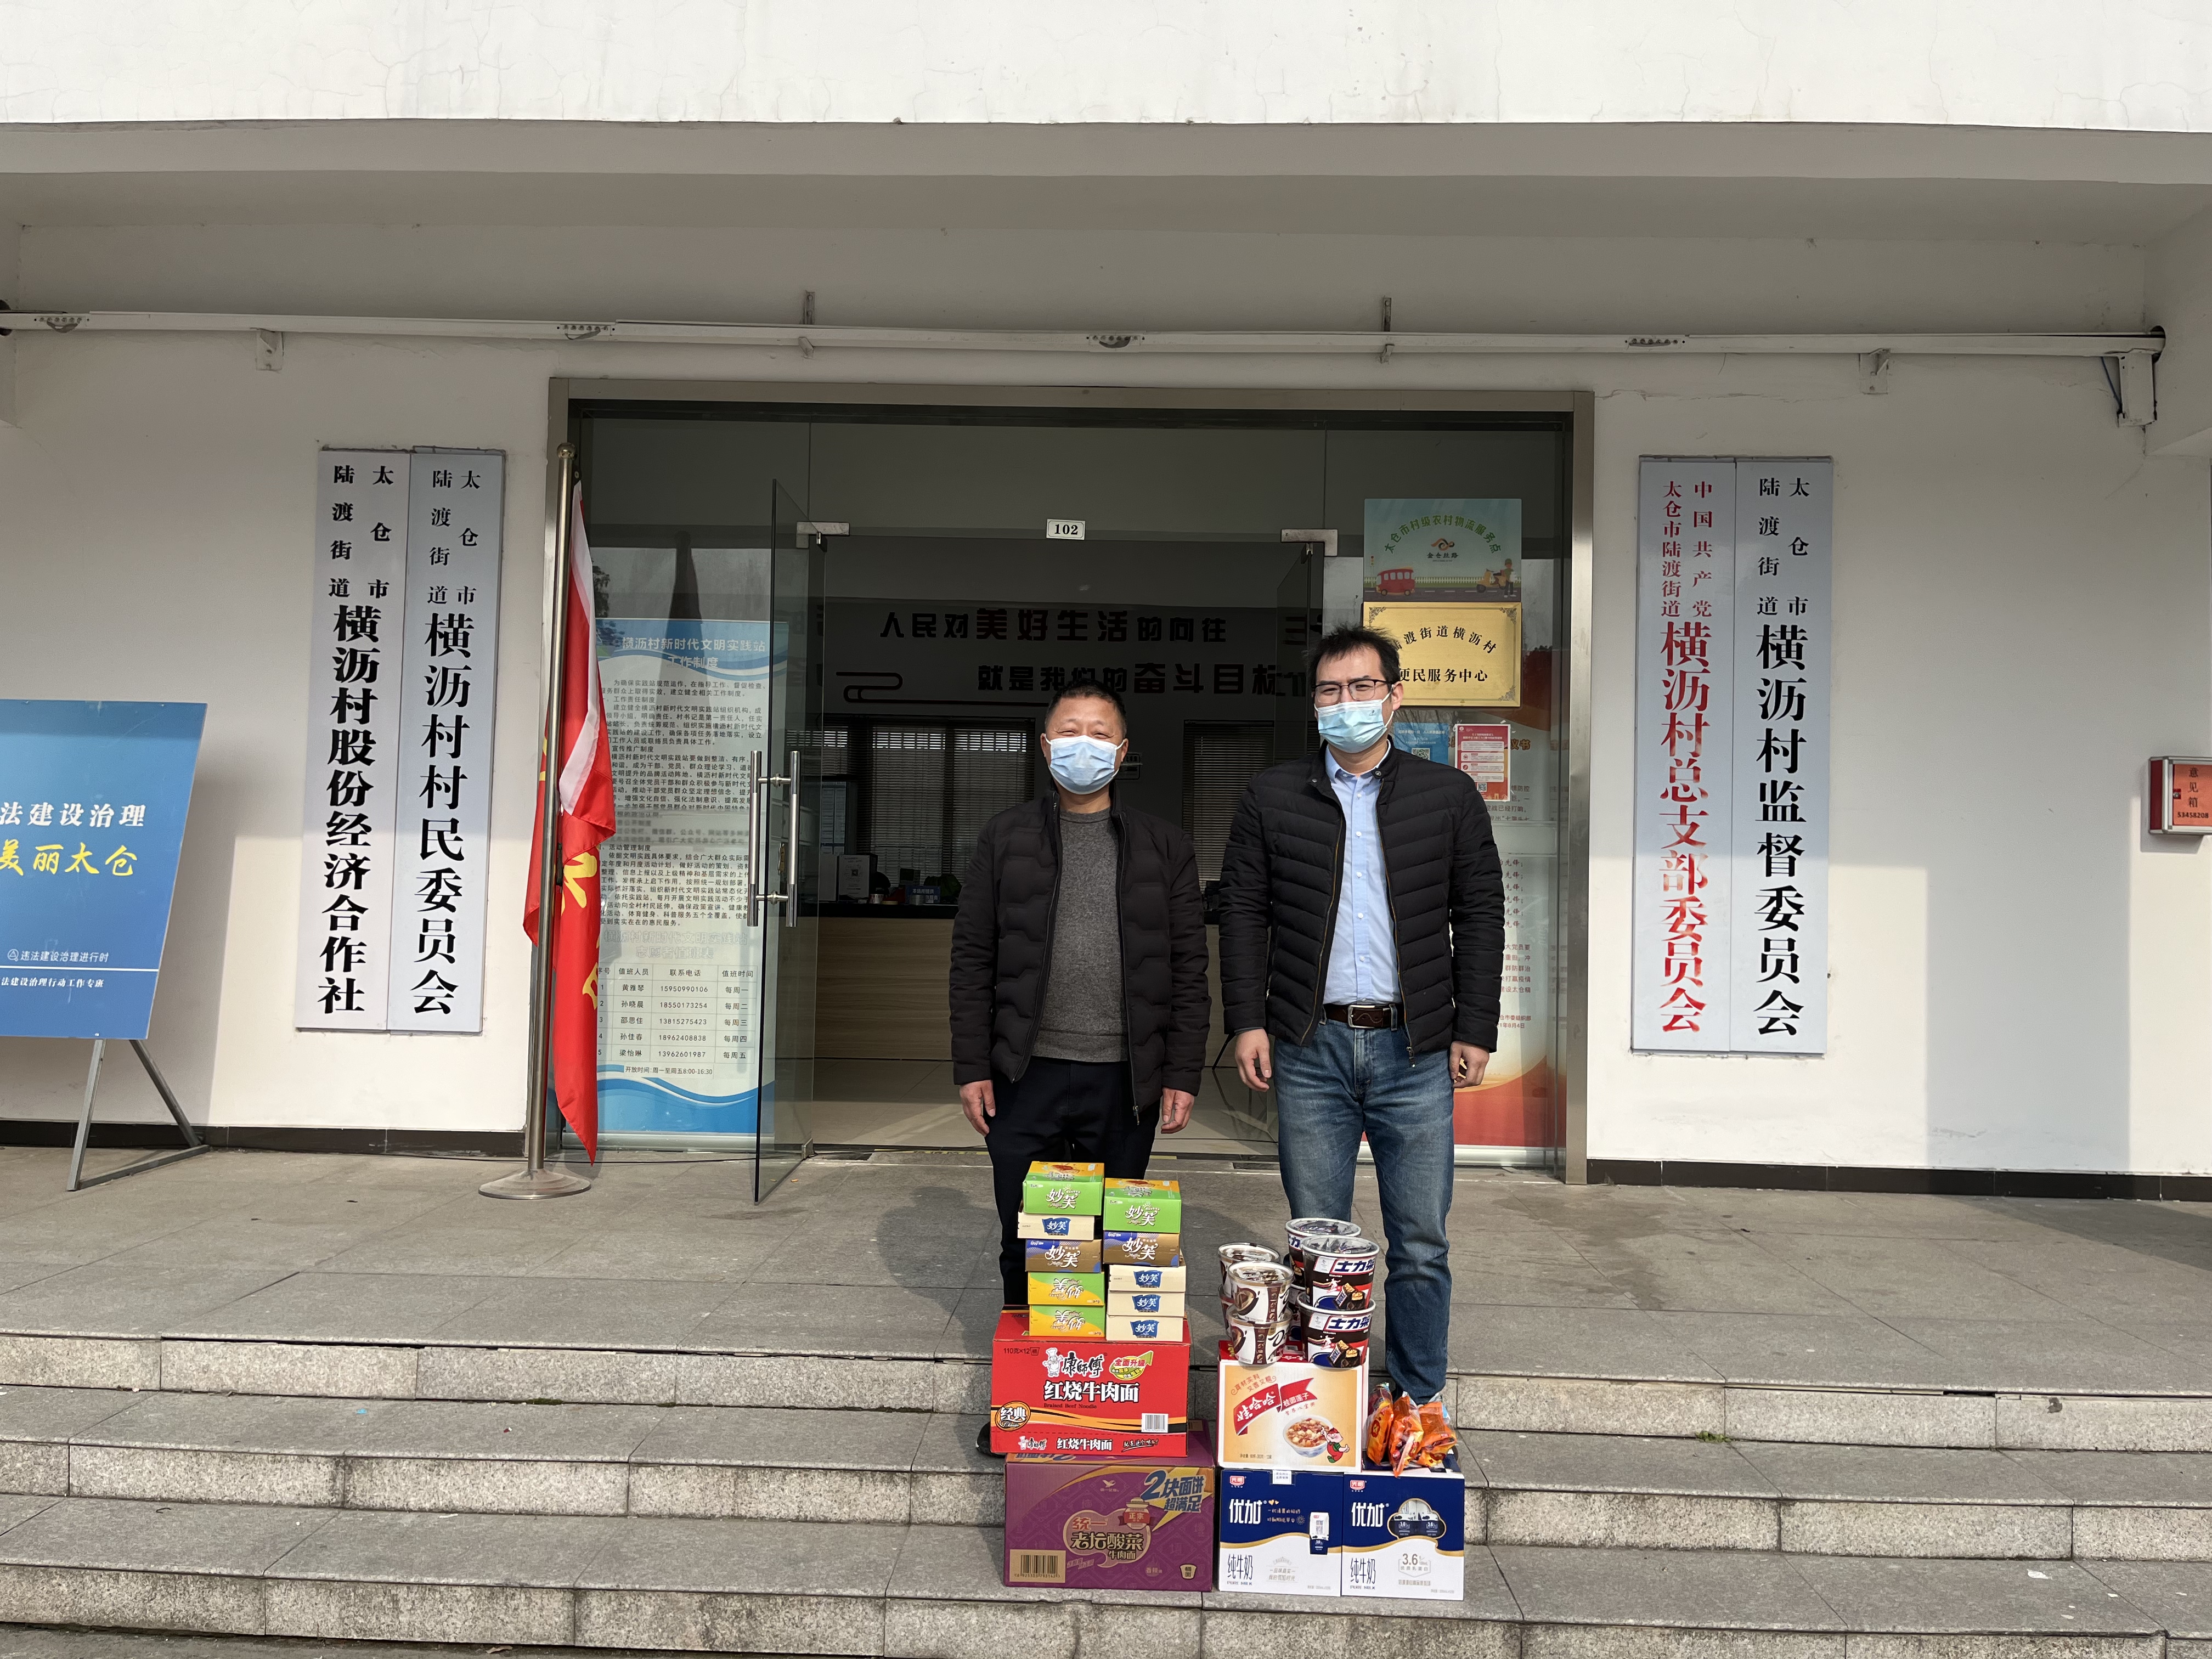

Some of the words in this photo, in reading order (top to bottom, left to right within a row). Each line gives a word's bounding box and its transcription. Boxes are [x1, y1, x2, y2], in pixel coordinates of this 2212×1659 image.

[329, 465, 355, 597] 陆渡街道
[368, 465, 394, 599] 太仓市
[427, 470, 453, 605] 陆渡街道
[456, 470, 481, 605] 太仓市
[1054, 524, 1079, 535] 102
[1385, 515, 1502, 554] 太仓市村级农村物流服务点
[1661, 481, 1681, 617] 太仓市陆渡街道
[1692, 481, 1712, 617] 中国共产党
[1757, 478, 1780, 616] 陆渡街道
[1787, 478, 1809, 616] 太仓市
[880, 608, 1226, 642] 人民对美好生活的向往
[622, 637, 765, 652] 横沥村新时代文明实践站
[667, 656, 719, 669] 工作制度
[1400, 668, 1487, 682] 便民服务中心
[2188, 767, 2199, 808] 意见箱
[0, 802, 146, 828] 法建设治理
[317, 605, 381, 1014] 横沥村股份经济合作社
[410, 612, 475, 1014] 横沥村村民委员会
[1659, 622, 1712, 1032] 横沥村总支部委员会
[1753, 624, 1808, 1035] 横沥村监督委员会
[0, 839, 137, 876] 美丽太仓
[20, 950, 109, 963] 违法建设治理进行时
[618, 968, 649, 976] 值班人员
[1046, 1189, 1079, 1209] 妙芙
[1046, 1221, 1068, 1230] 妙芙
[1125, 1205, 1158, 1226] 妙芙
[1045, 1245, 1080, 1268] 妙芙
[1122, 1237, 1158, 1260] 妙芙
[1334, 1259, 1375, 1272] 士力架
[1138, 1273, 1159, 1283] 妙芙
[1137, 1297, 1158, 1307] 妙芙
[1135, 1323, 1156, 1333] 妙芙
[1328, 1315, 1370, 1329] 士力架
[1044, 1381, 1139, 1403] 红烧牛肉面
[1000, 1407, 1026, 1421] 经典
[1237, 1392, 1276, 1422] 娃哈哈
[1057, 1438, 1113, 1451] 红烧牛肉面
[1141, 1470, 1204, 1500] 2块面饼
[1164, 1495, 1203, 1512] 超满足
[1229, 1499, 1262, 1524] 优加
[1351, 1502, 1384, 1527] 优加
[1072, 1517, 1107, 1530] 统一
[1071, 1532, 1144, 1551] 老坛酸菜
[1108, 1550, 1136, 1560] 牛肉面
[1227, 1553, 1253, 1580] 纯牛奶
[1402, 1553, 1418, 1565] 3.6
[1350, 1558, 1376, 1584] 纯牛奶
